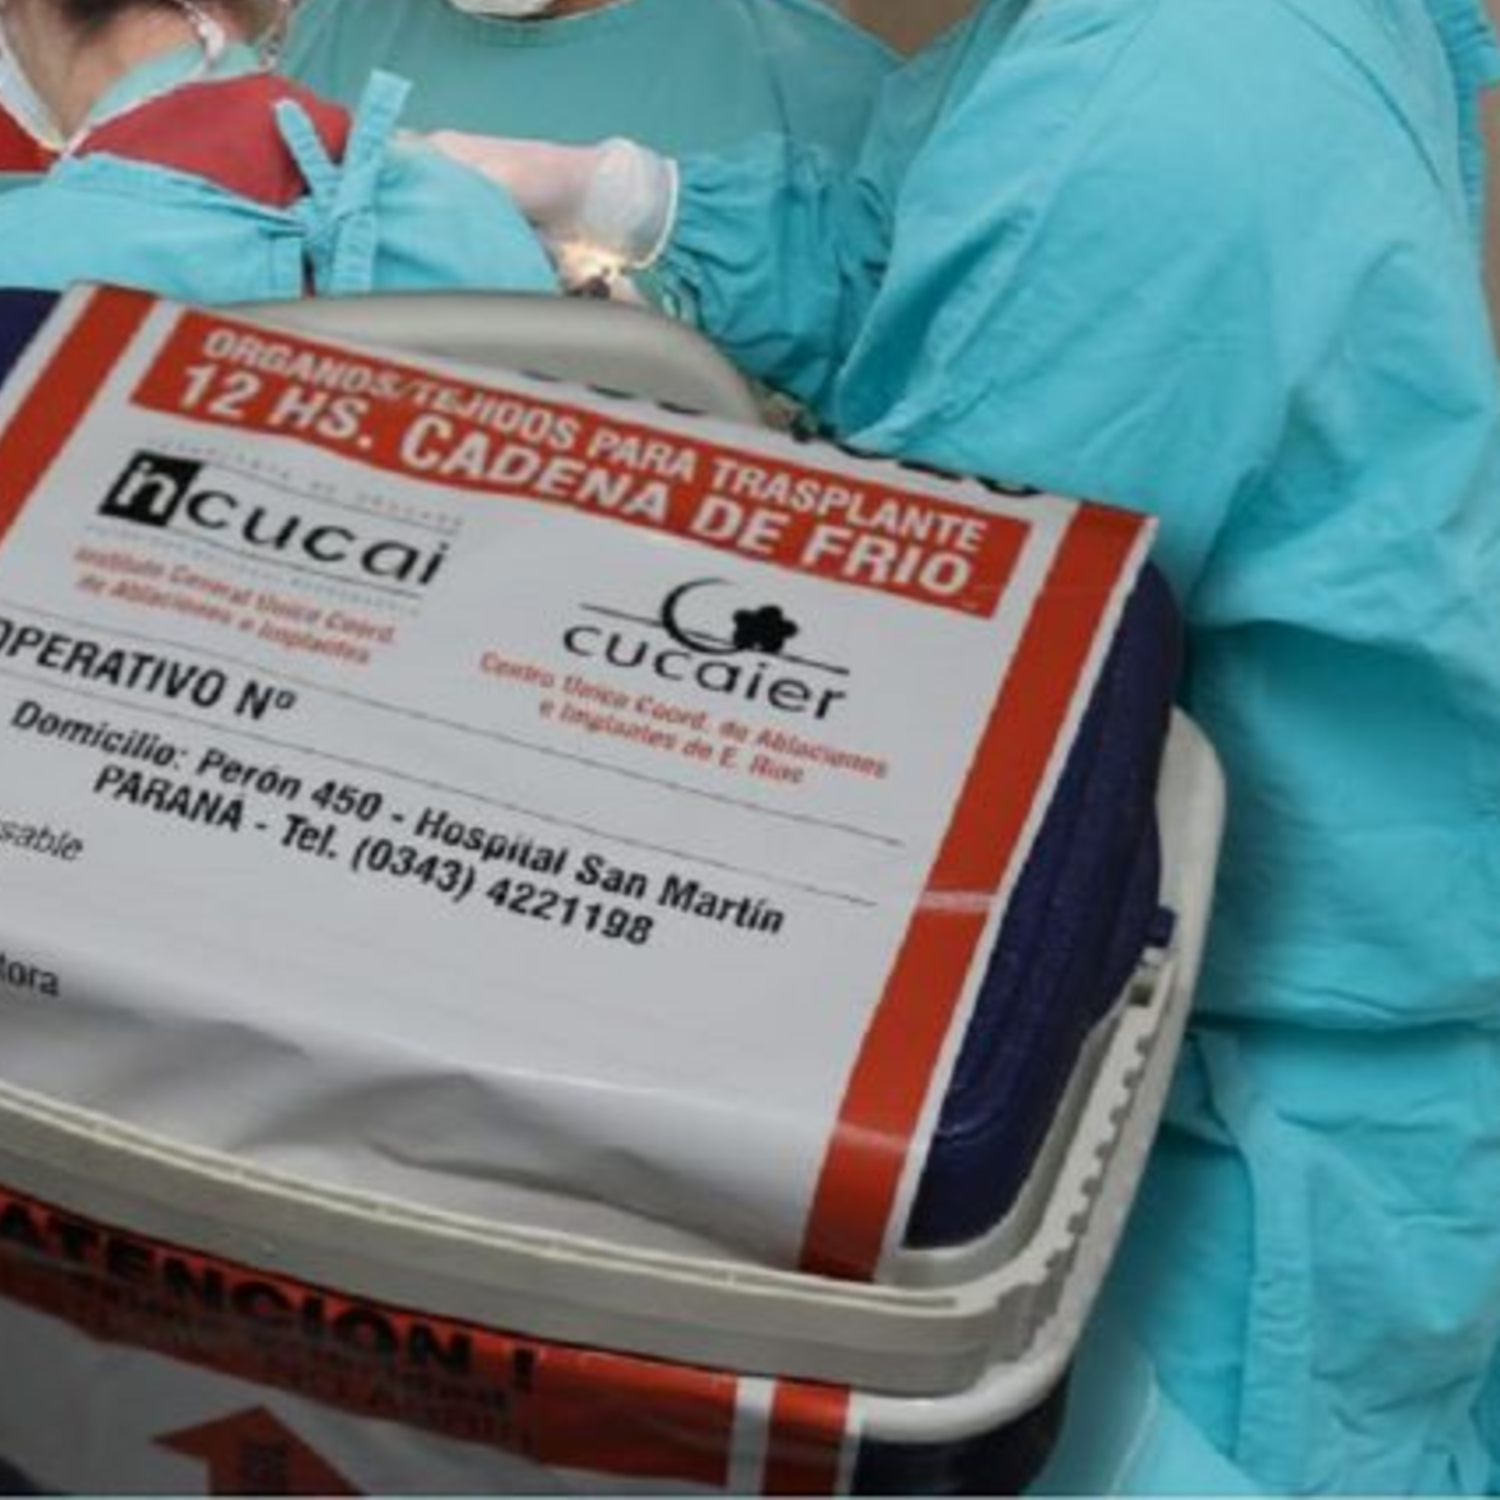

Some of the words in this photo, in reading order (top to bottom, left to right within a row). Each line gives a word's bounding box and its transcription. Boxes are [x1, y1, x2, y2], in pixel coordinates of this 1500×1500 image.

[176, 363, 262, 419] 12
[268, 380, 373, 449] HS.
[400, 413, 669, 522] CADENA
[691, 496, 790, 555] DE
[801, 524, 972, 597] FRIO
[585, 429, 695, 483] PARA
[710, 457, 987, 553] TRASPLANTE
[234, 680, 298, 721] Nº
[559, 703, 677, 751] Implantes
[682, 739, 713, 761] de
[562, 624, 846, 720] cucaier
[10, 699, 189, 772] Domicilio:
[195, 748, 303, 801] Perón
[311, 779, 383, 823] 450
[414, 806, 569, 877] Hospital
[574, 853, 649, 901] San
[657, 874, 787, 935] Martín
[281, 813, 338, 859] Tel.
[351, 834, 477, 903] (0343)
[485, 877, 654, 947] 4221198
